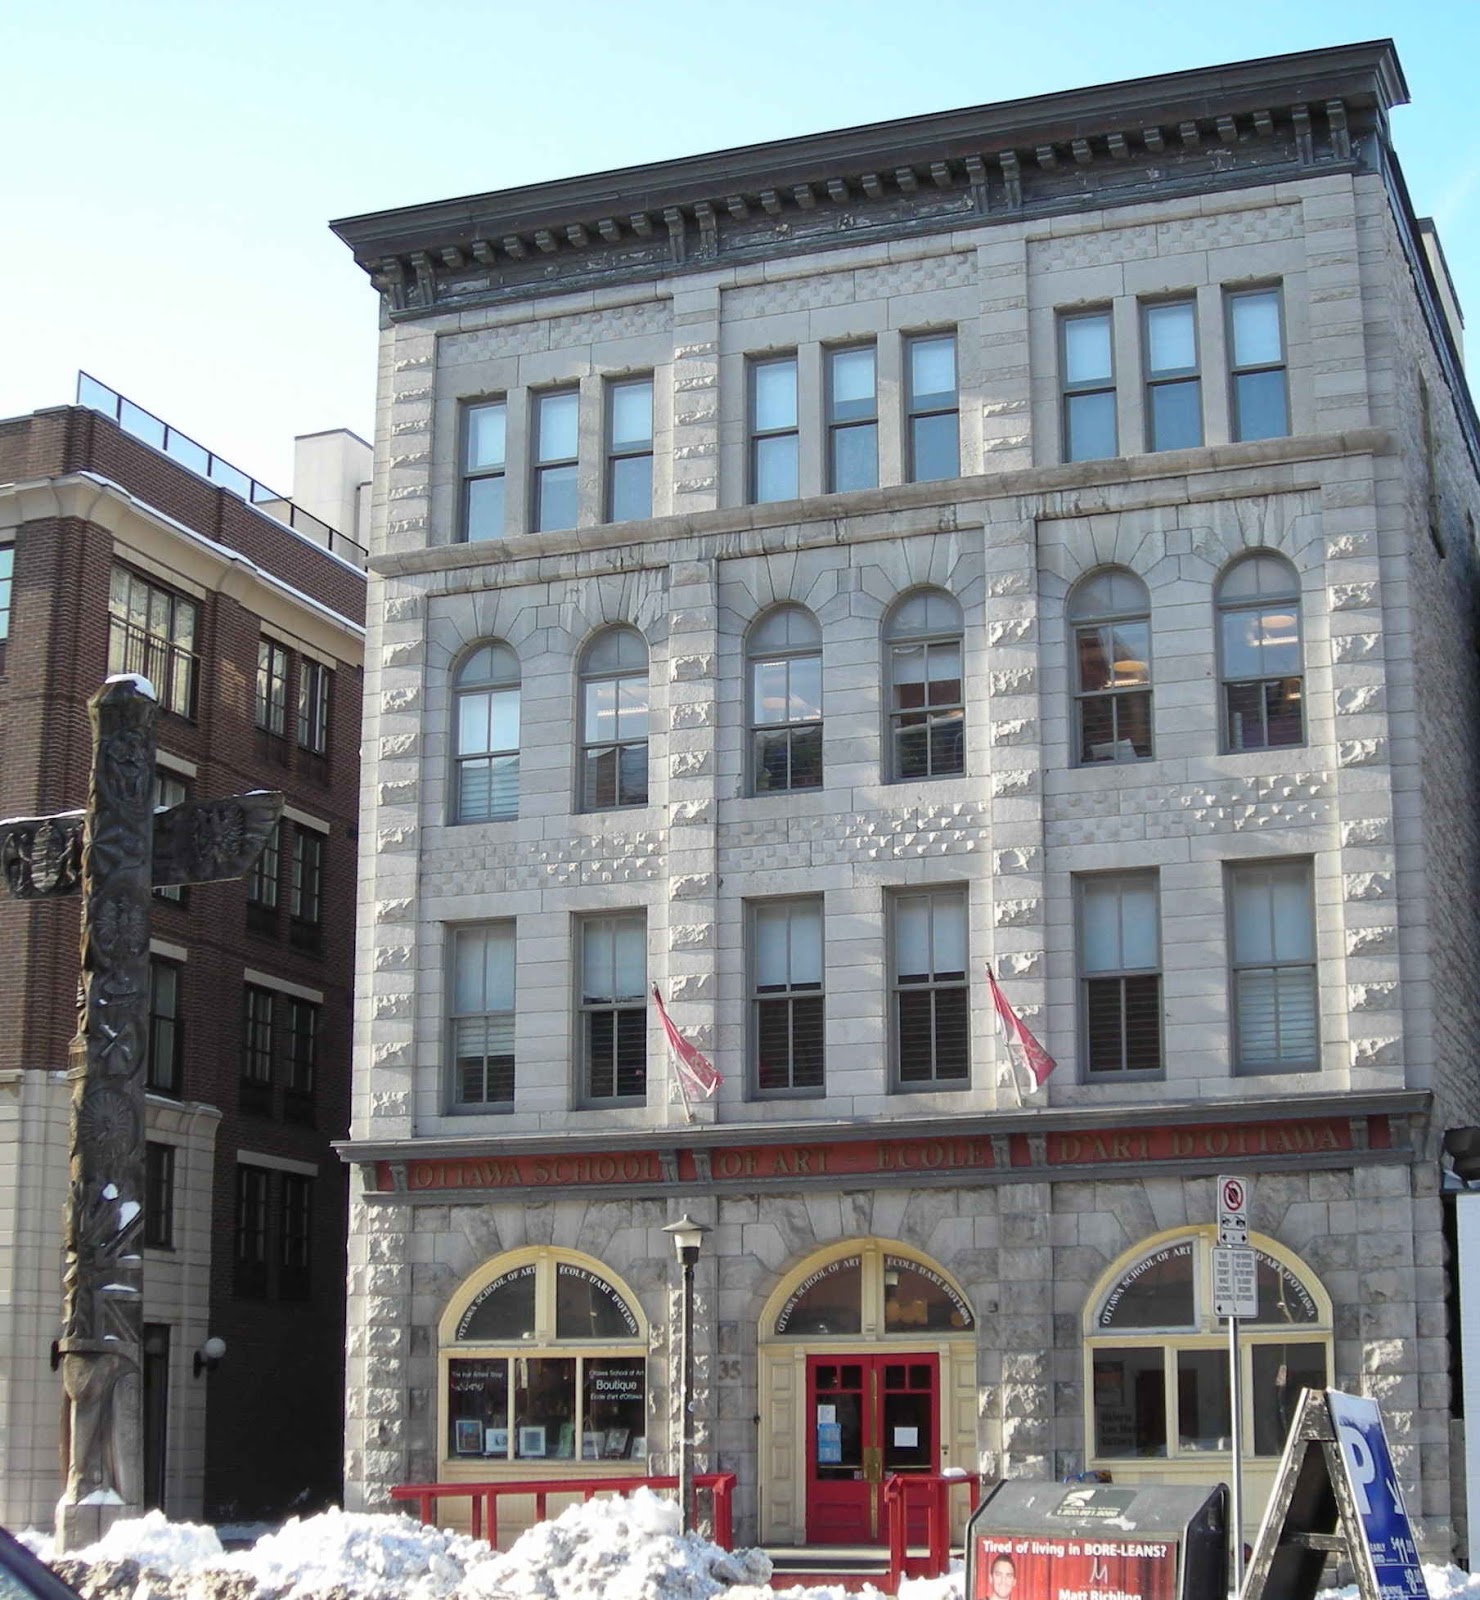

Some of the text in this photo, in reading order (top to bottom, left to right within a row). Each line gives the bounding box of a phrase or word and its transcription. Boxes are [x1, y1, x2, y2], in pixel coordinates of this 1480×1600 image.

[414, 1160, 522, 1187] OTTAWA
[533, 1156, 661, 1185] SCHOOL
[718, 1152, 756, 1176] OF
[772, 1149, 833, 1174] ART
[1059, 1132, 1153, 1162] D'ART
[1171, 1124, 1343, 1156] D'OTTAWA
[475, 1277, 507, 1306] SCHOOL
[507, 1273, 518, 1282] OF
[520, 1266, 536, 1277] ART
[588, 1275, 613, 1294] D'ART
[611, 1293, 638, 1334] D'OTTAWA
[777, 1258, 860, 1332] OTTAWA SCHOOL OF ART
[1102, 1245, 1192, 1325] OTTAWA SCHOOL OF ART
[1283, 1271, 1316, 1317] D'OTTAWA
[596, 1379, 637, 1392] Boutique
[718, 1360, 741, 1381] 35
[1339, 1425, 1376, 1515] P
[982, 1540, 1167, 1558] Tired of living in BORE-LEANS?
